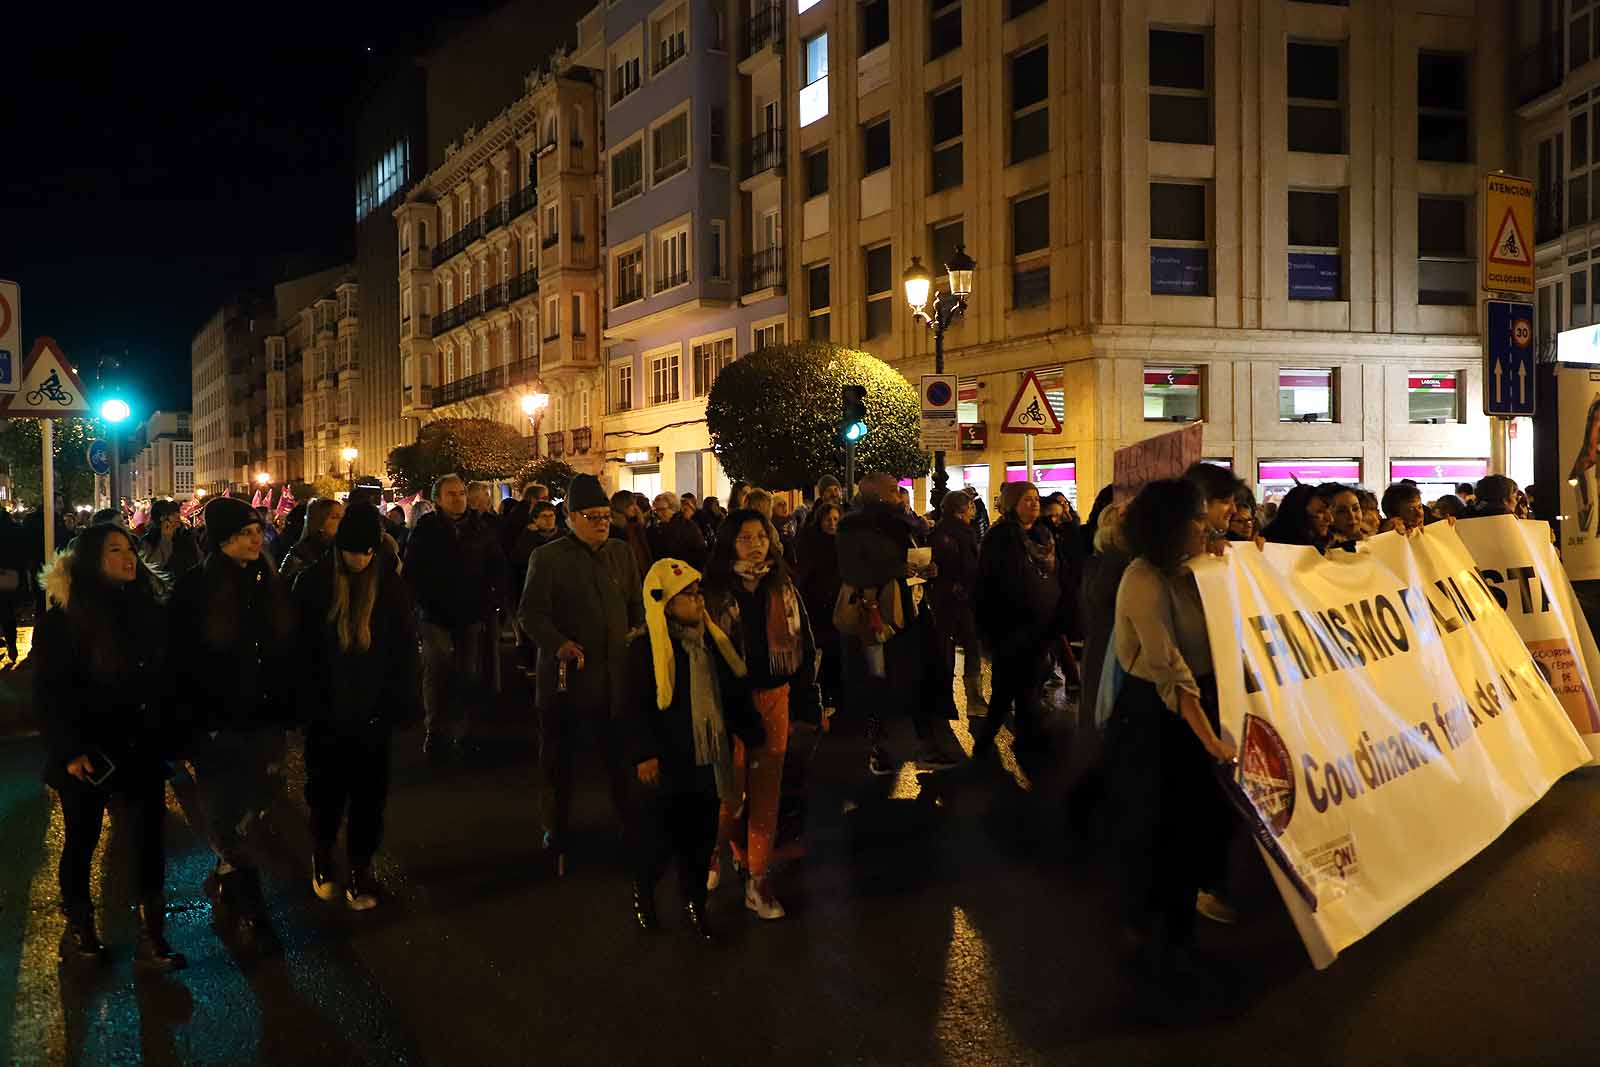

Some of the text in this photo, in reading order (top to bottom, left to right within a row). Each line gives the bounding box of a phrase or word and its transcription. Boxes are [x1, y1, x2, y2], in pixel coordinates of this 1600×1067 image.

[1488, 181, 1531, 198] ATENCIÓN
[1516, 327, 1528, 338] 30
[1247, 593, 1410, 687] FMINISMO
[1301, 721, 1443, 814] Coordinadoa
